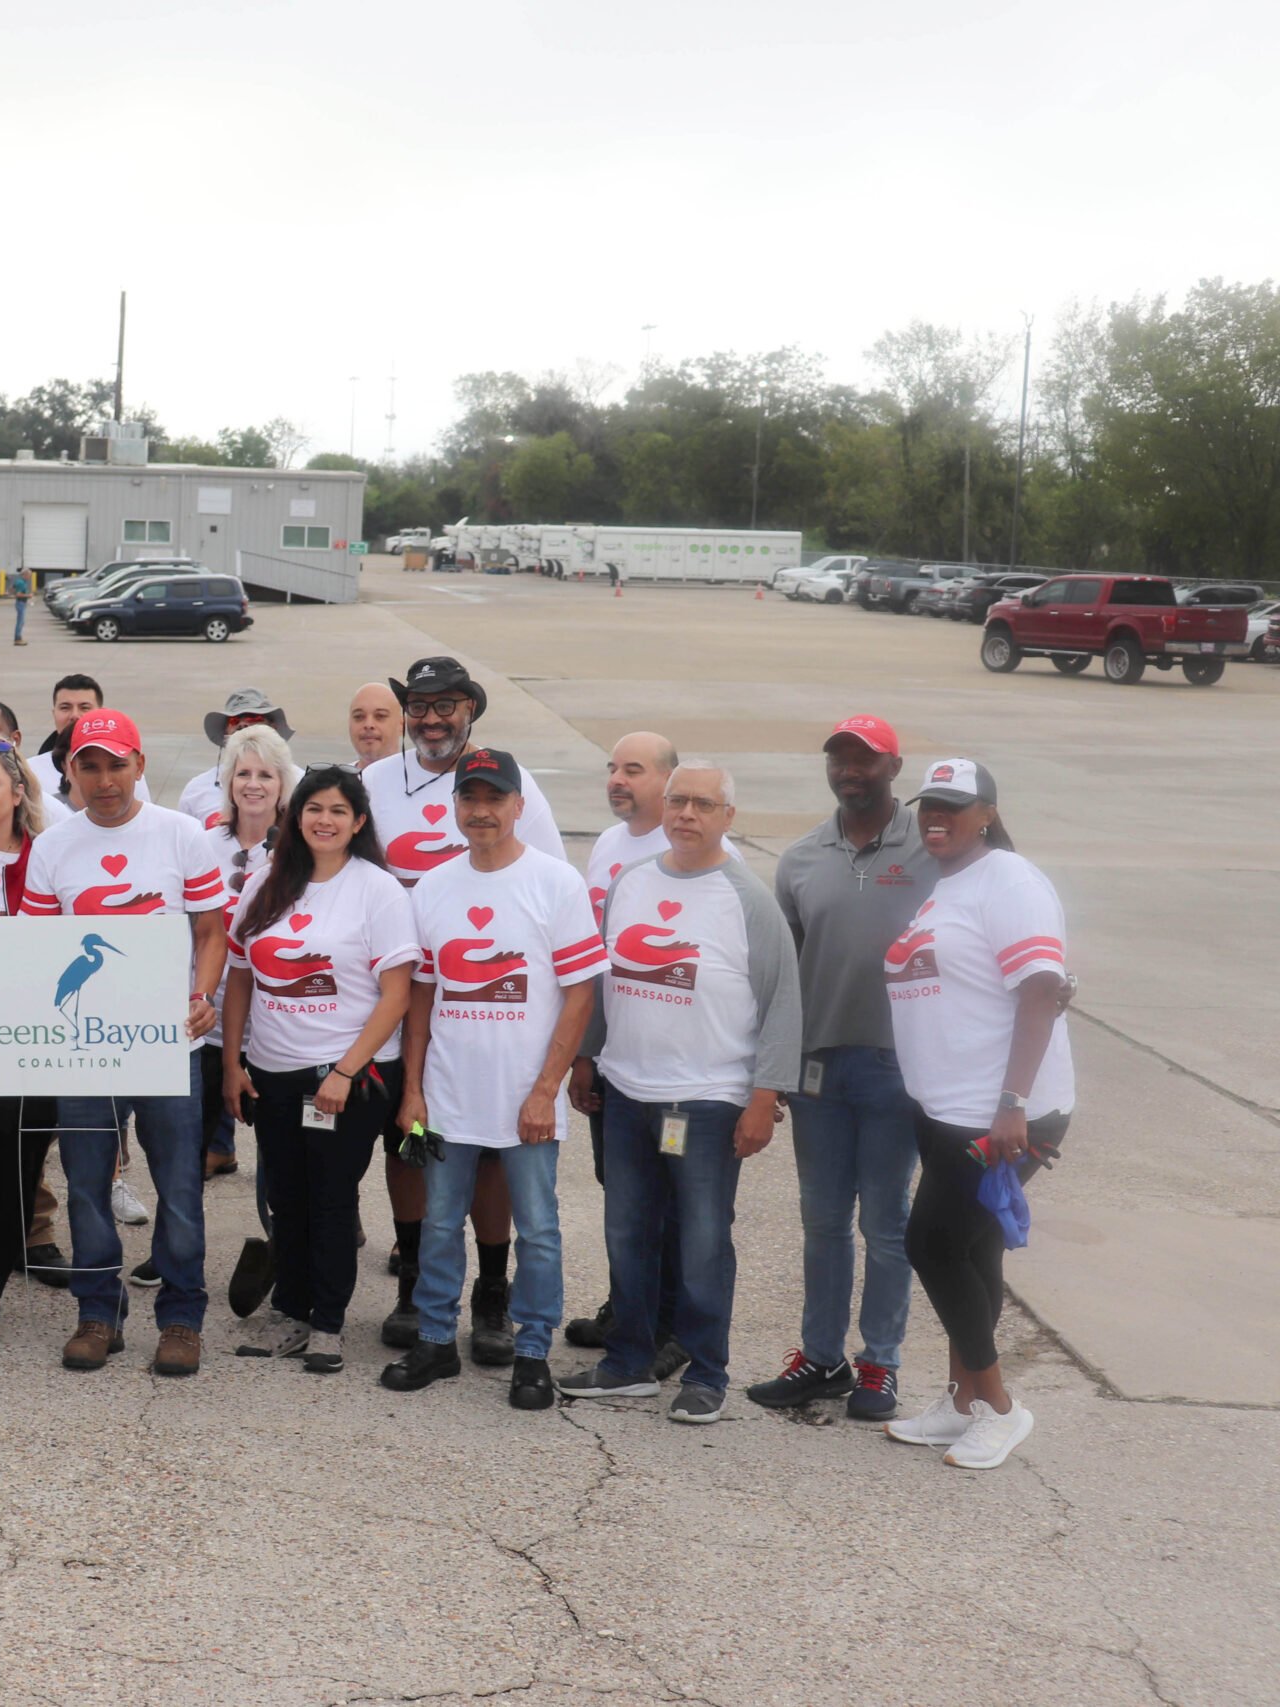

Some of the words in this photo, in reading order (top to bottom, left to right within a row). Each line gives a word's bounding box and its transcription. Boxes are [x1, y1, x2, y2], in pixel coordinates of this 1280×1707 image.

[439, 1009, 525, 1021] AMBASSADOR
[84, 1016, 179, 1052] Bayou
[18, 1058, 121, 1068] COALITION
